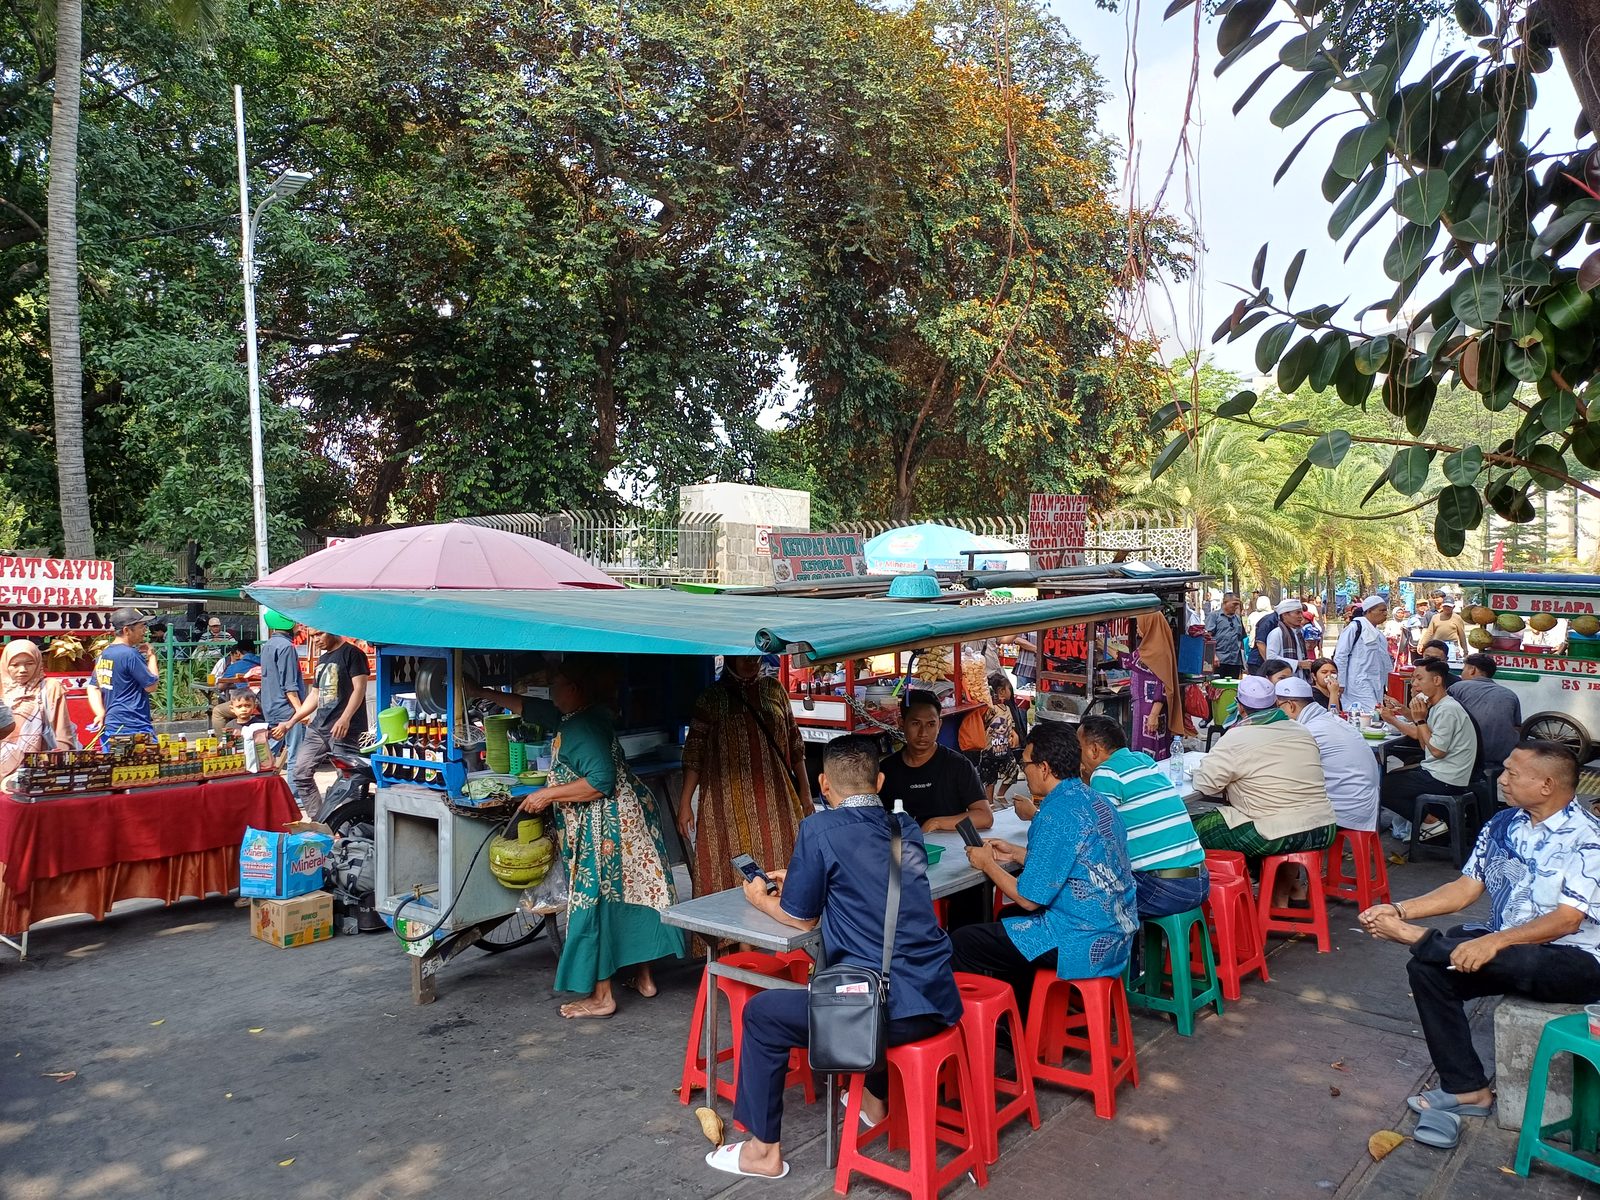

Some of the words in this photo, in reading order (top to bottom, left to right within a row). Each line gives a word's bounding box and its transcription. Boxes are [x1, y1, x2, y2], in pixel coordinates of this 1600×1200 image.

[1054, 512, 1086, 522] GORENG
[781, 537, 825, 557] KETUPAT
[826, 536, 858, 556] SAYUR
[43, 559, 113, 580] SAYUR
[800, 559, 845, 572] KETOPRAK
[1492, 594, 1519, 610] ES
[1530, 599, 1594, 614] KELAPA
[1493, 655, 1539, 669] ELAPA
[1544, 658, 1568, 672] ES
[1562, 680, 1580, 691] ES
[253, 842, 262, 850] Le
[304, 846, 315, 859] Le
[243, 848, 273, 858] Minerale
